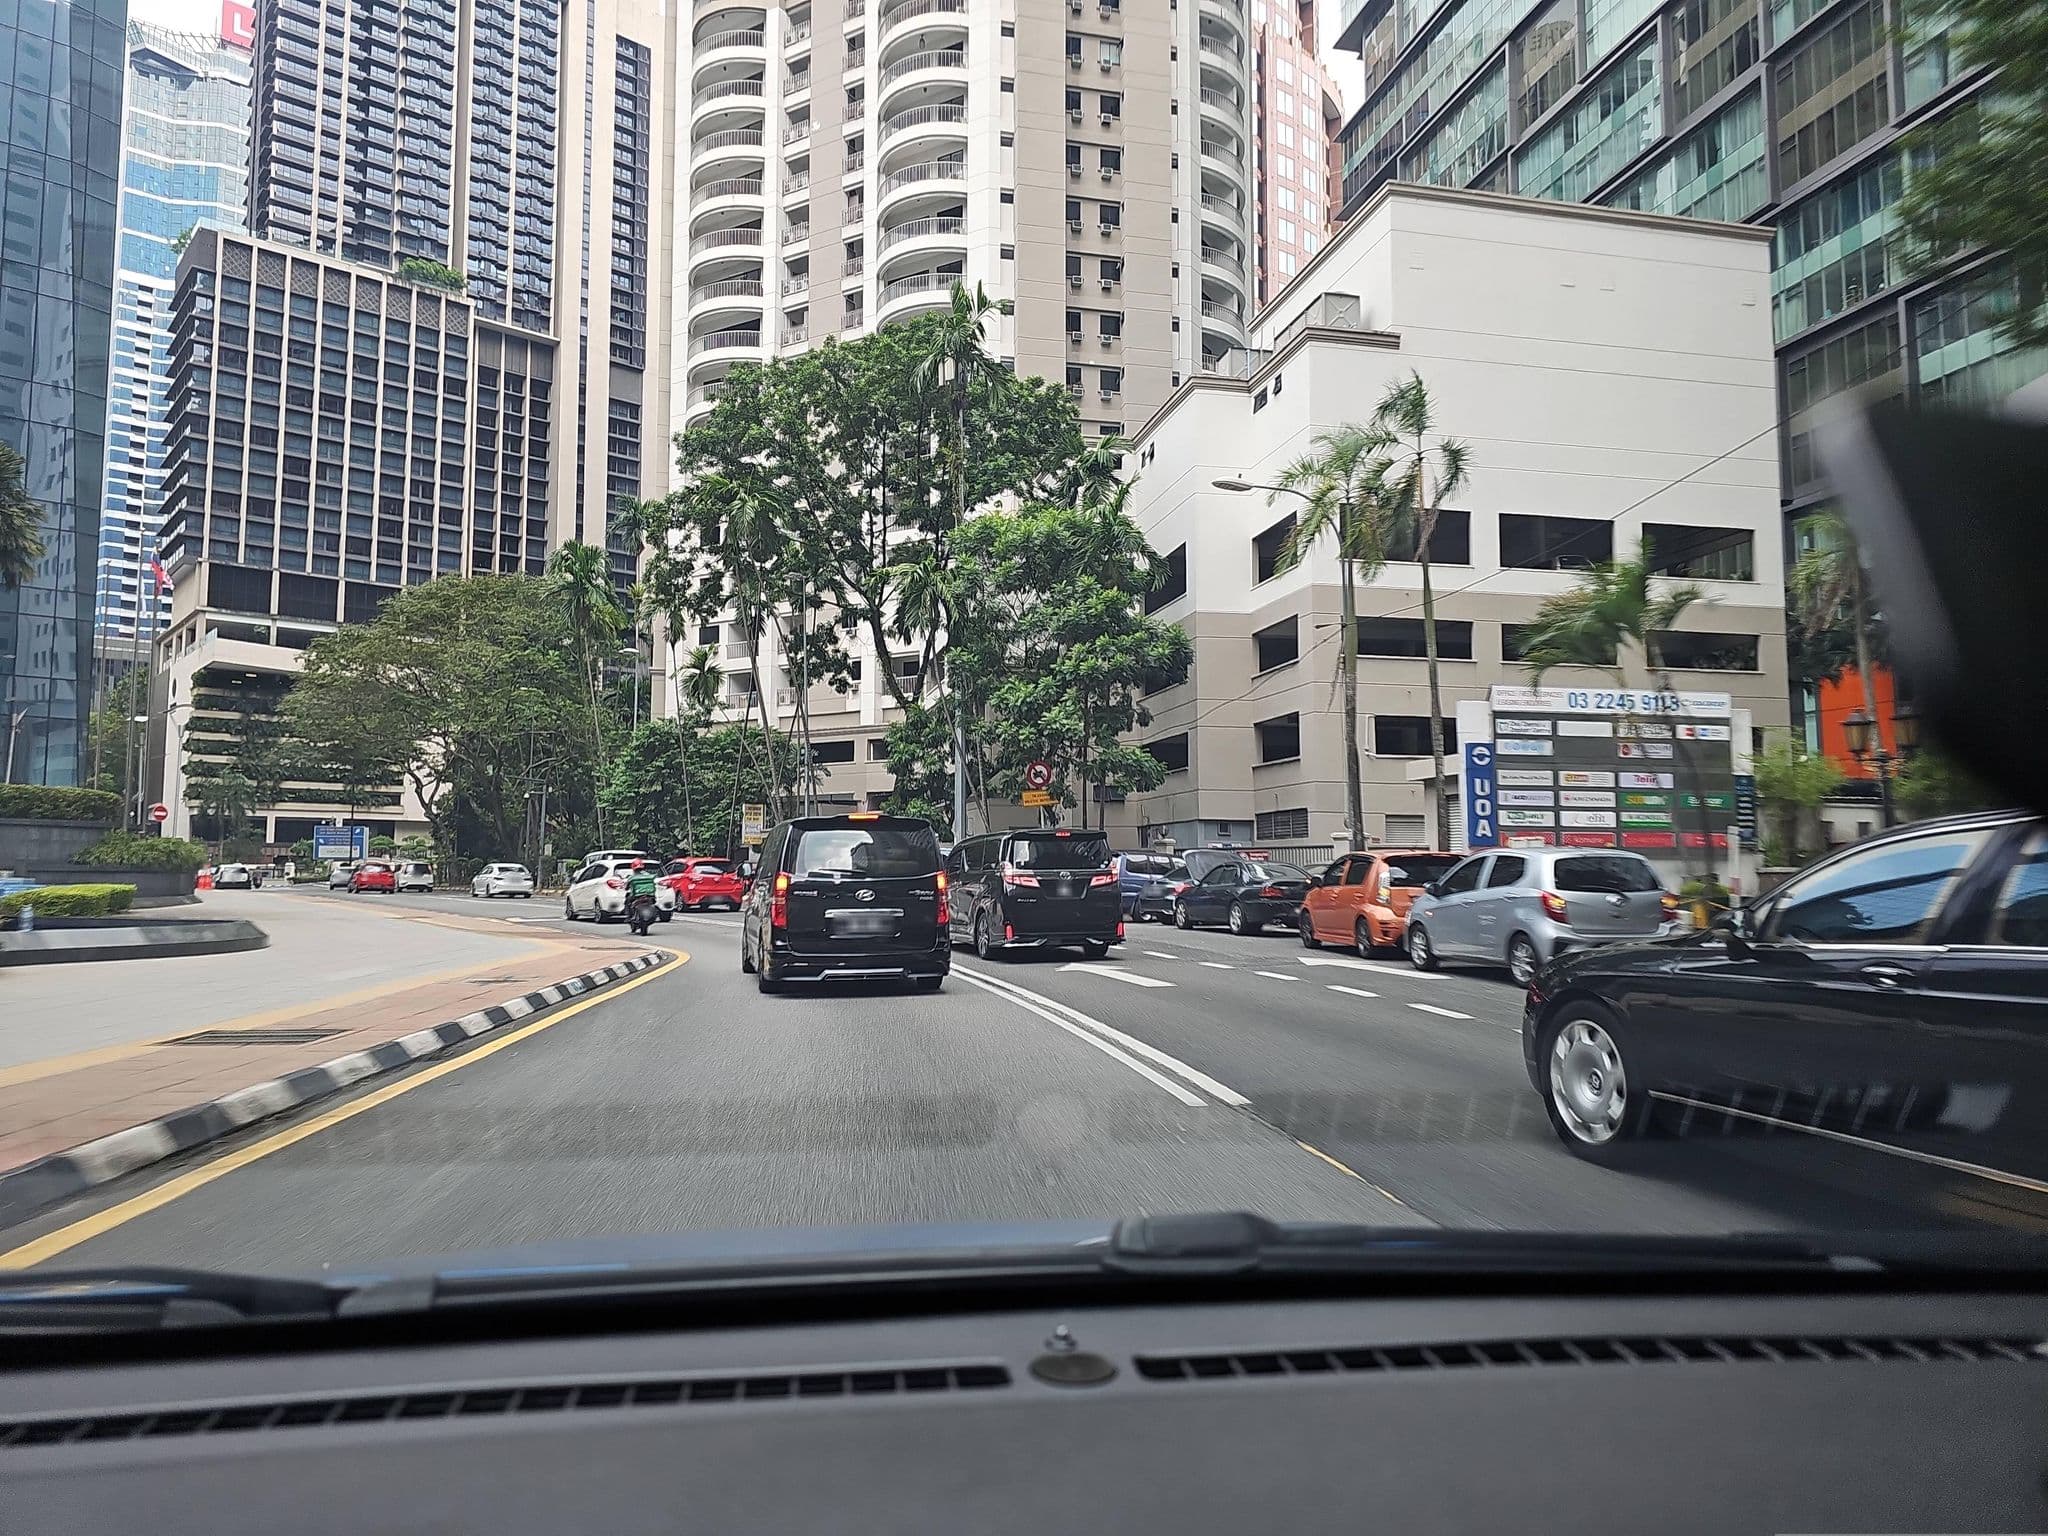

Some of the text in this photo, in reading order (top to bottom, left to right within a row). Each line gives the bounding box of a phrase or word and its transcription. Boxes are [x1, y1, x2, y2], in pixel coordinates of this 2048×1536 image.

[1568, 691, 1588, 709] 03
[1594, 692, 1635, 711] 2245
[1473, 777, 1493, 838] UOA
